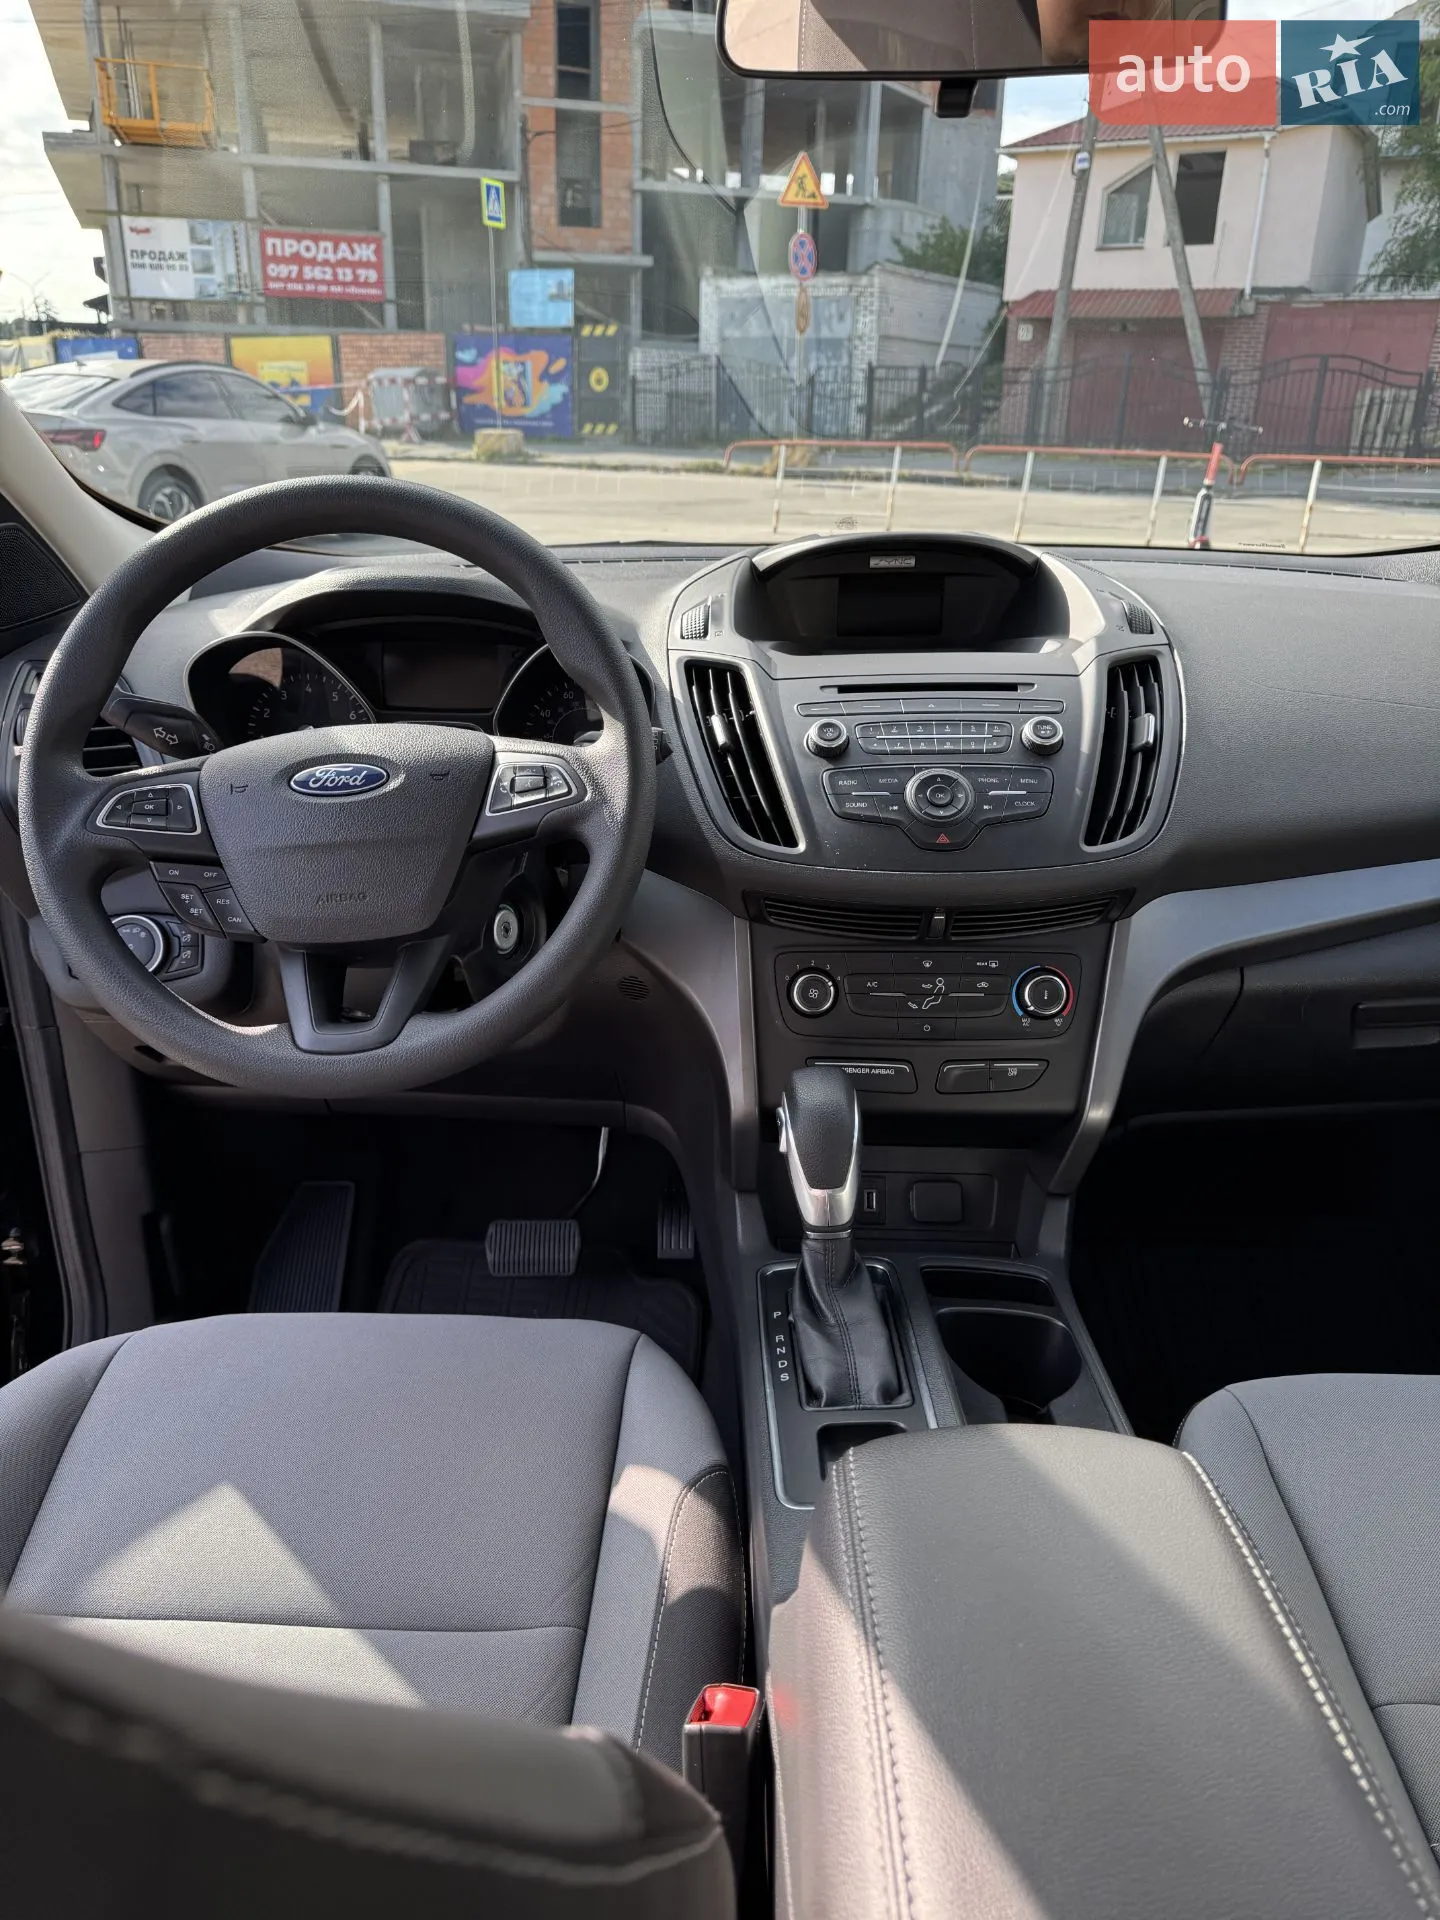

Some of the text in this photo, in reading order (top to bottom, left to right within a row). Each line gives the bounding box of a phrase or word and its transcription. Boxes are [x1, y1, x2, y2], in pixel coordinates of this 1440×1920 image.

[130, 249, 188, 261] ПРОДАЖ
[266, 237, 377, 263] ПРОДАЖ
[267, 263, 299, 278] 097
[336, 268, 353, 281] 13
[356, 268, 378, 283] 79
[263, 683, 357, 720] 2 3 4 5 6
[540, 709, 551, 717] 40
[308, 766, 367, 790] Ford
[313, 892, 368, 906] AIRBAG
[773, 1311, 782, 1319] P
[776, 1335, 785, 1343] R
[776, 1346, 786, 1355] N
[778, 1360, 788, 1368] D
[780, 1373, 790, 1381] S
